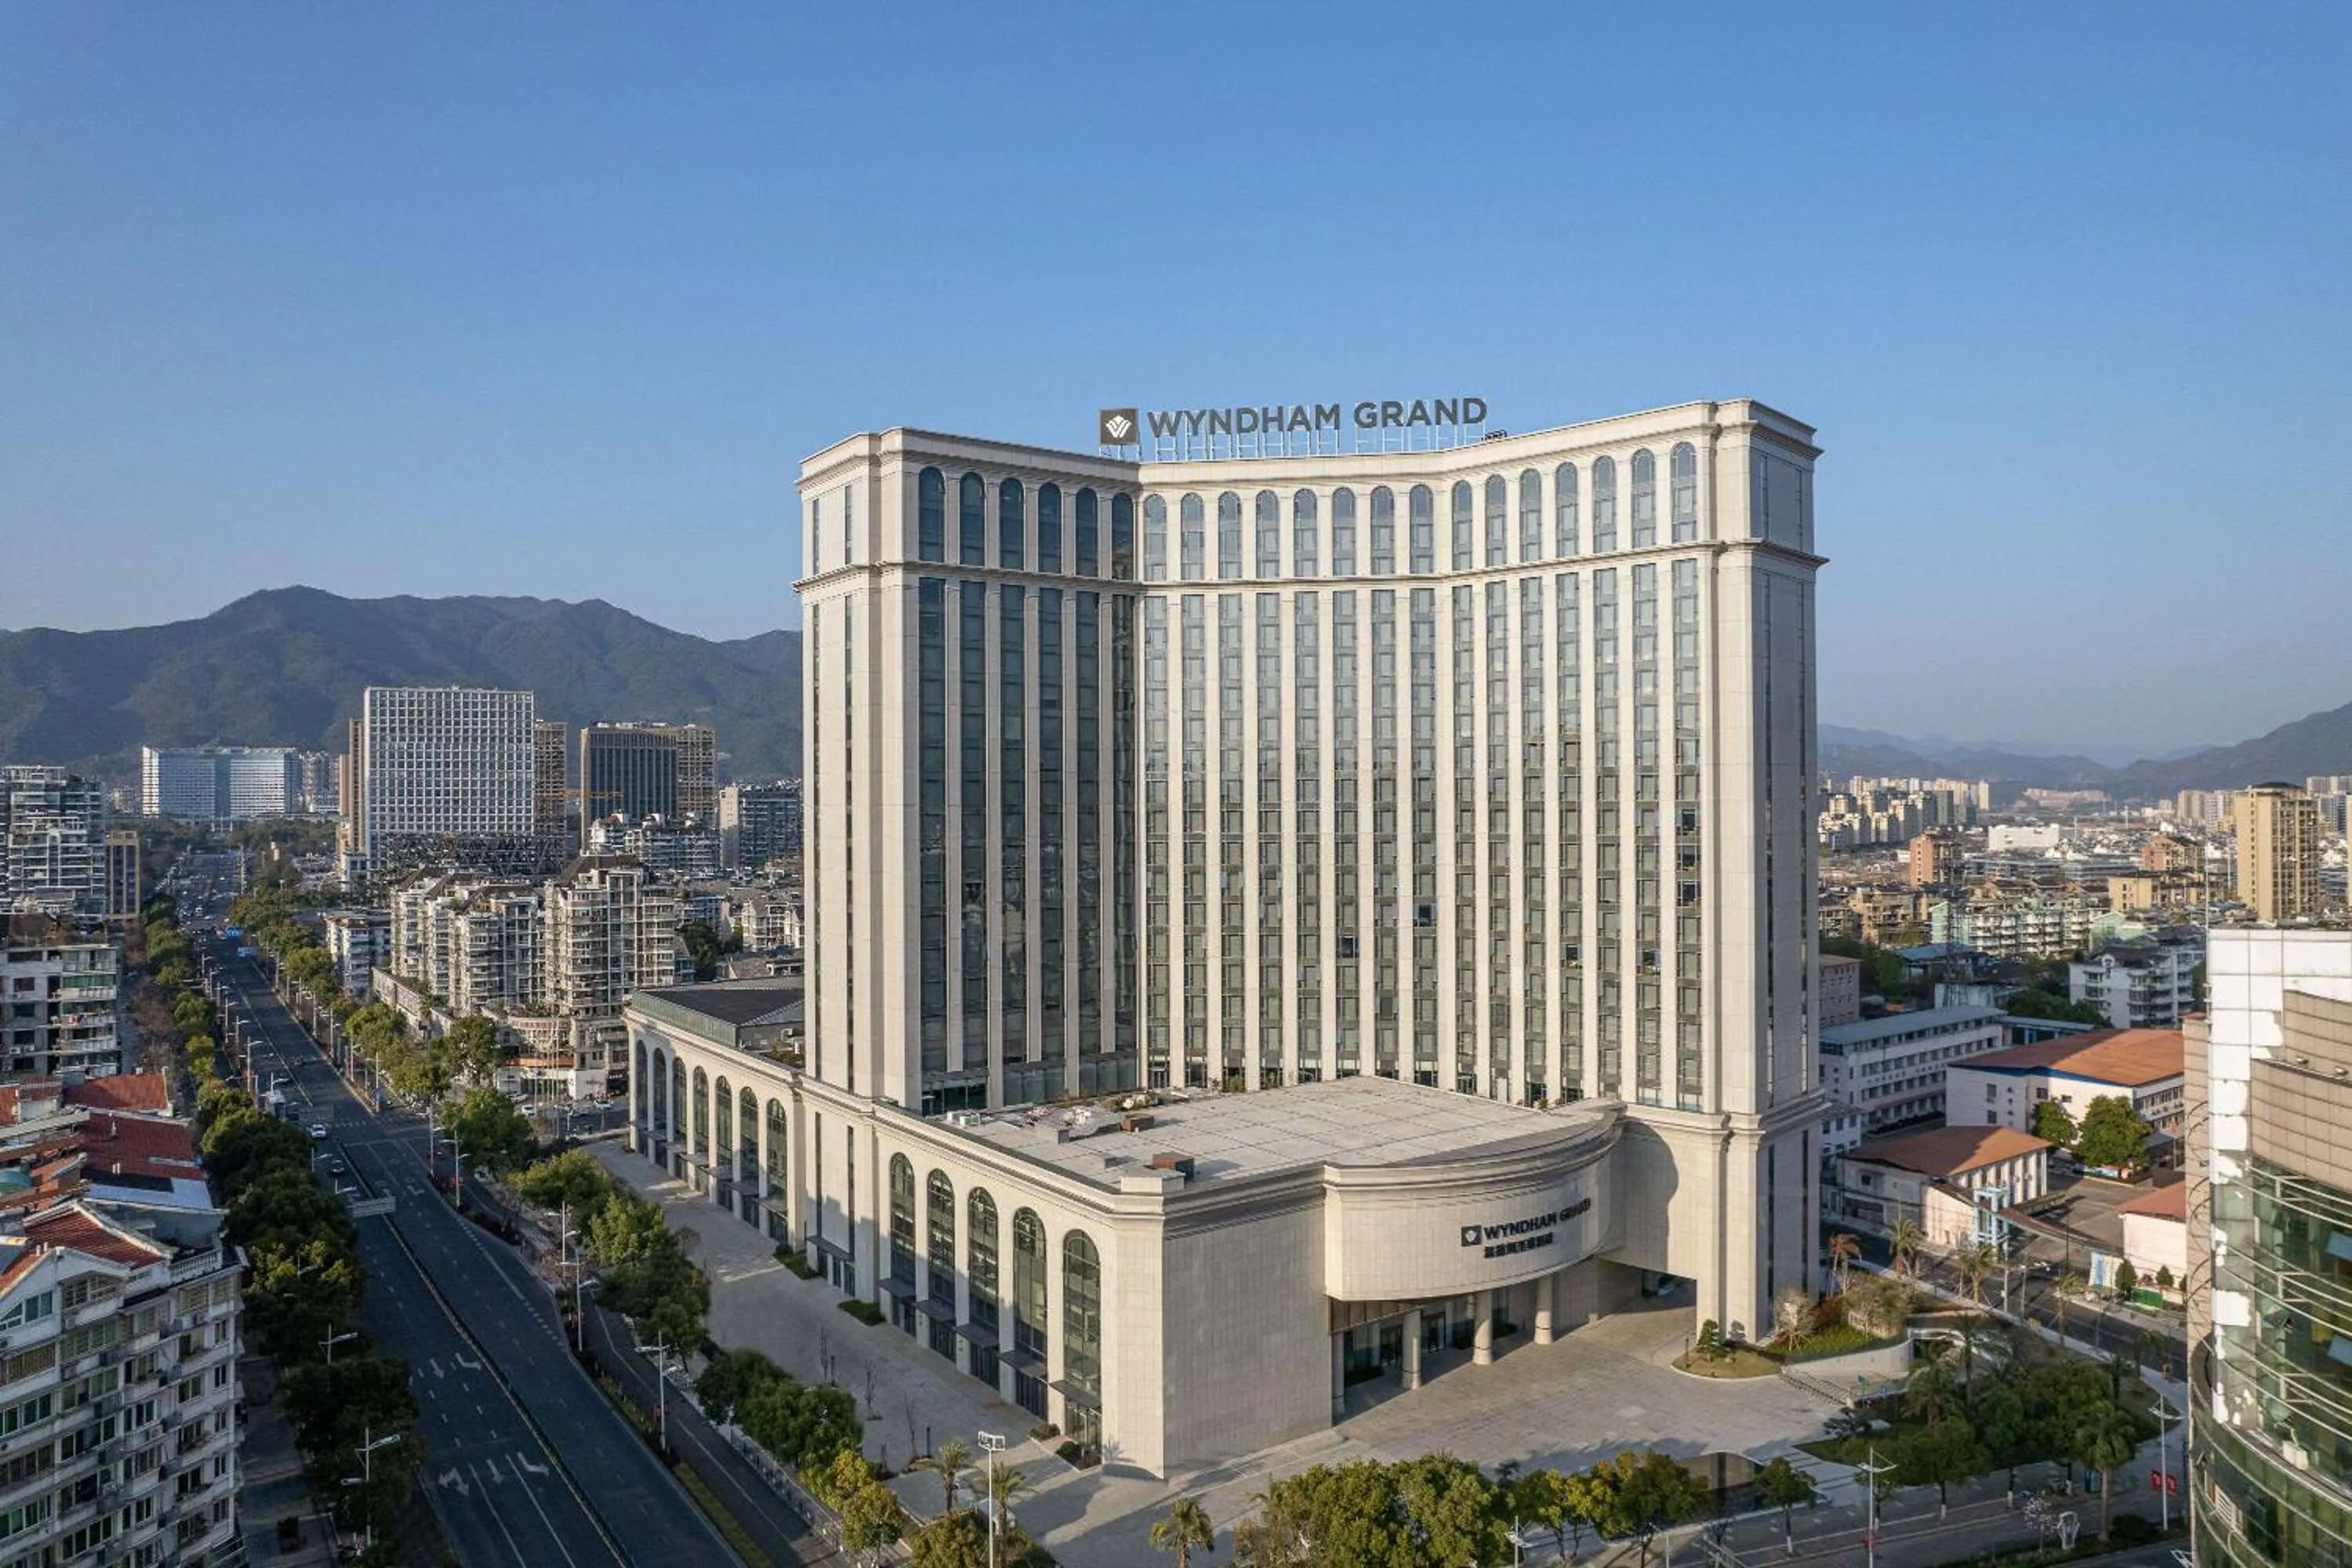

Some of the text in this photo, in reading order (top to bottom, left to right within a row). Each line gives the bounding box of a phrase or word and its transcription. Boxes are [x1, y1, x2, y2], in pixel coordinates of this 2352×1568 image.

[1147, 397, 1487, 438] WYNDHAM GRAND
[1483, 1212, 1557, 1240] WYNDHAM
